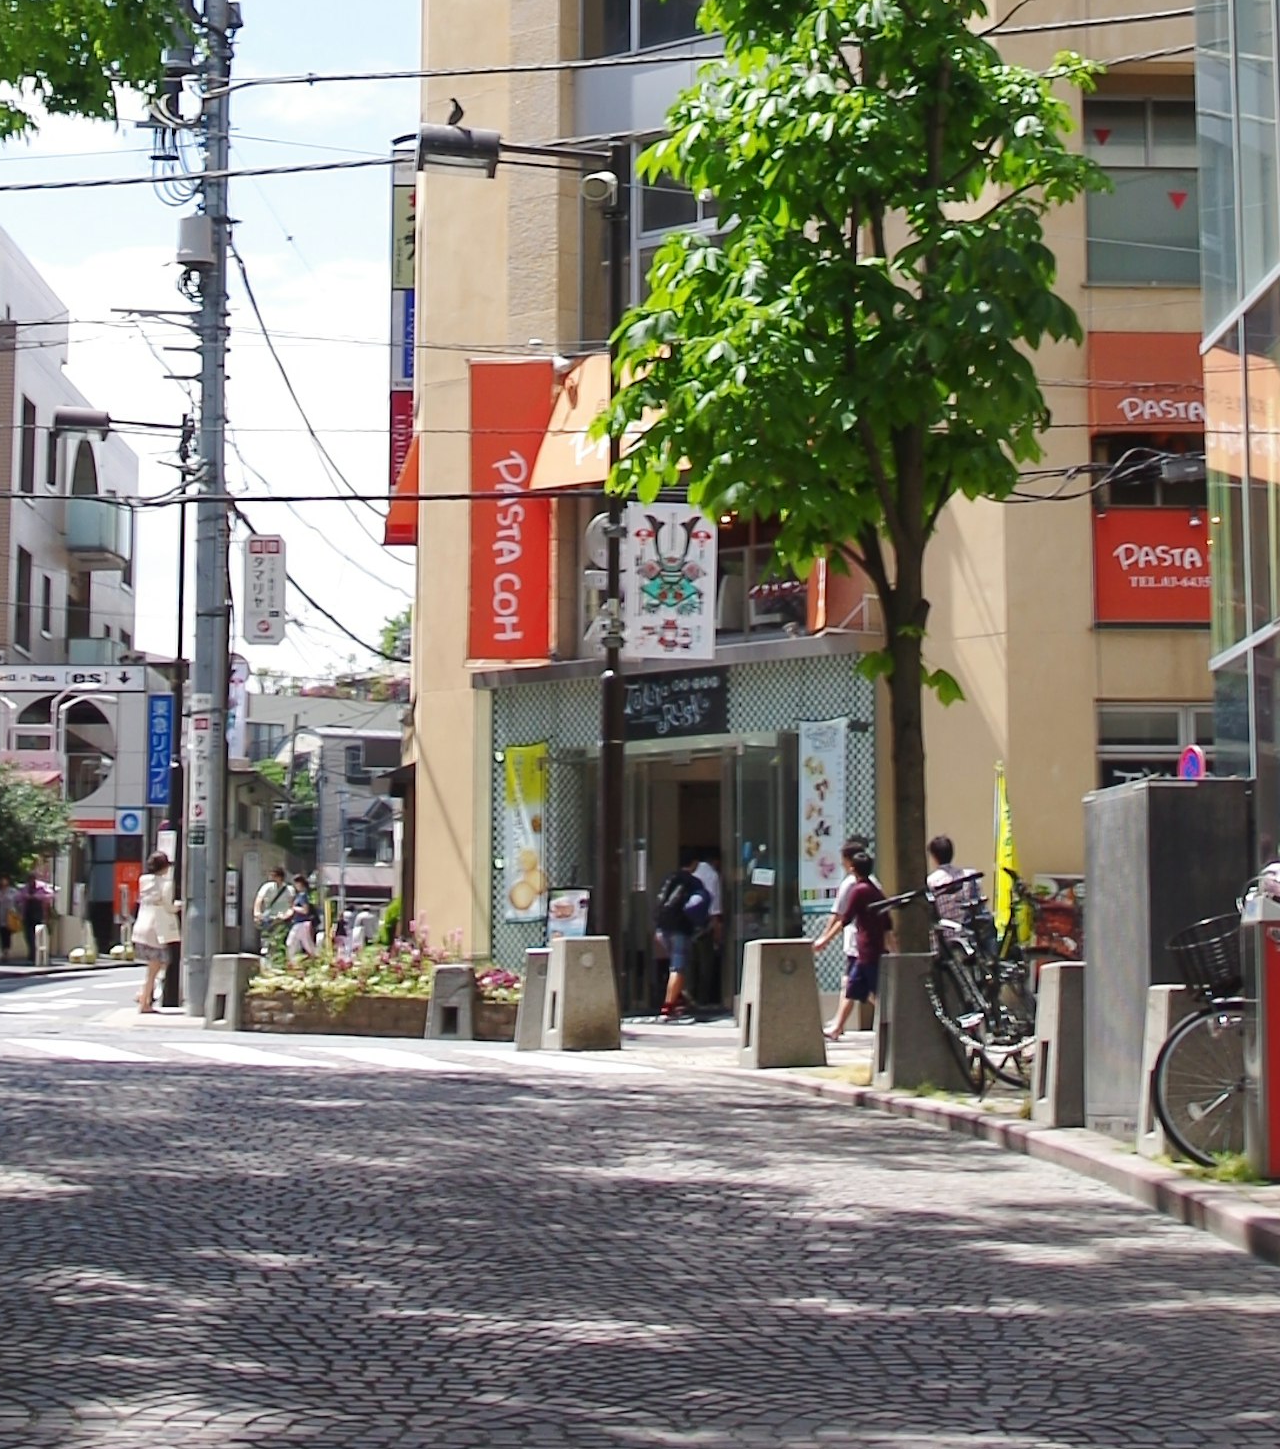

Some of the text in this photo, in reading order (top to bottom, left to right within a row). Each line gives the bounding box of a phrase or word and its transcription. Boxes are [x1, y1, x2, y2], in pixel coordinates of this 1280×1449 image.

[1117, 397, 1206, 422] PASTA
[491, 450, 529, 641] PASTA COH
[1112, 543, 1203, 571] PASTA
